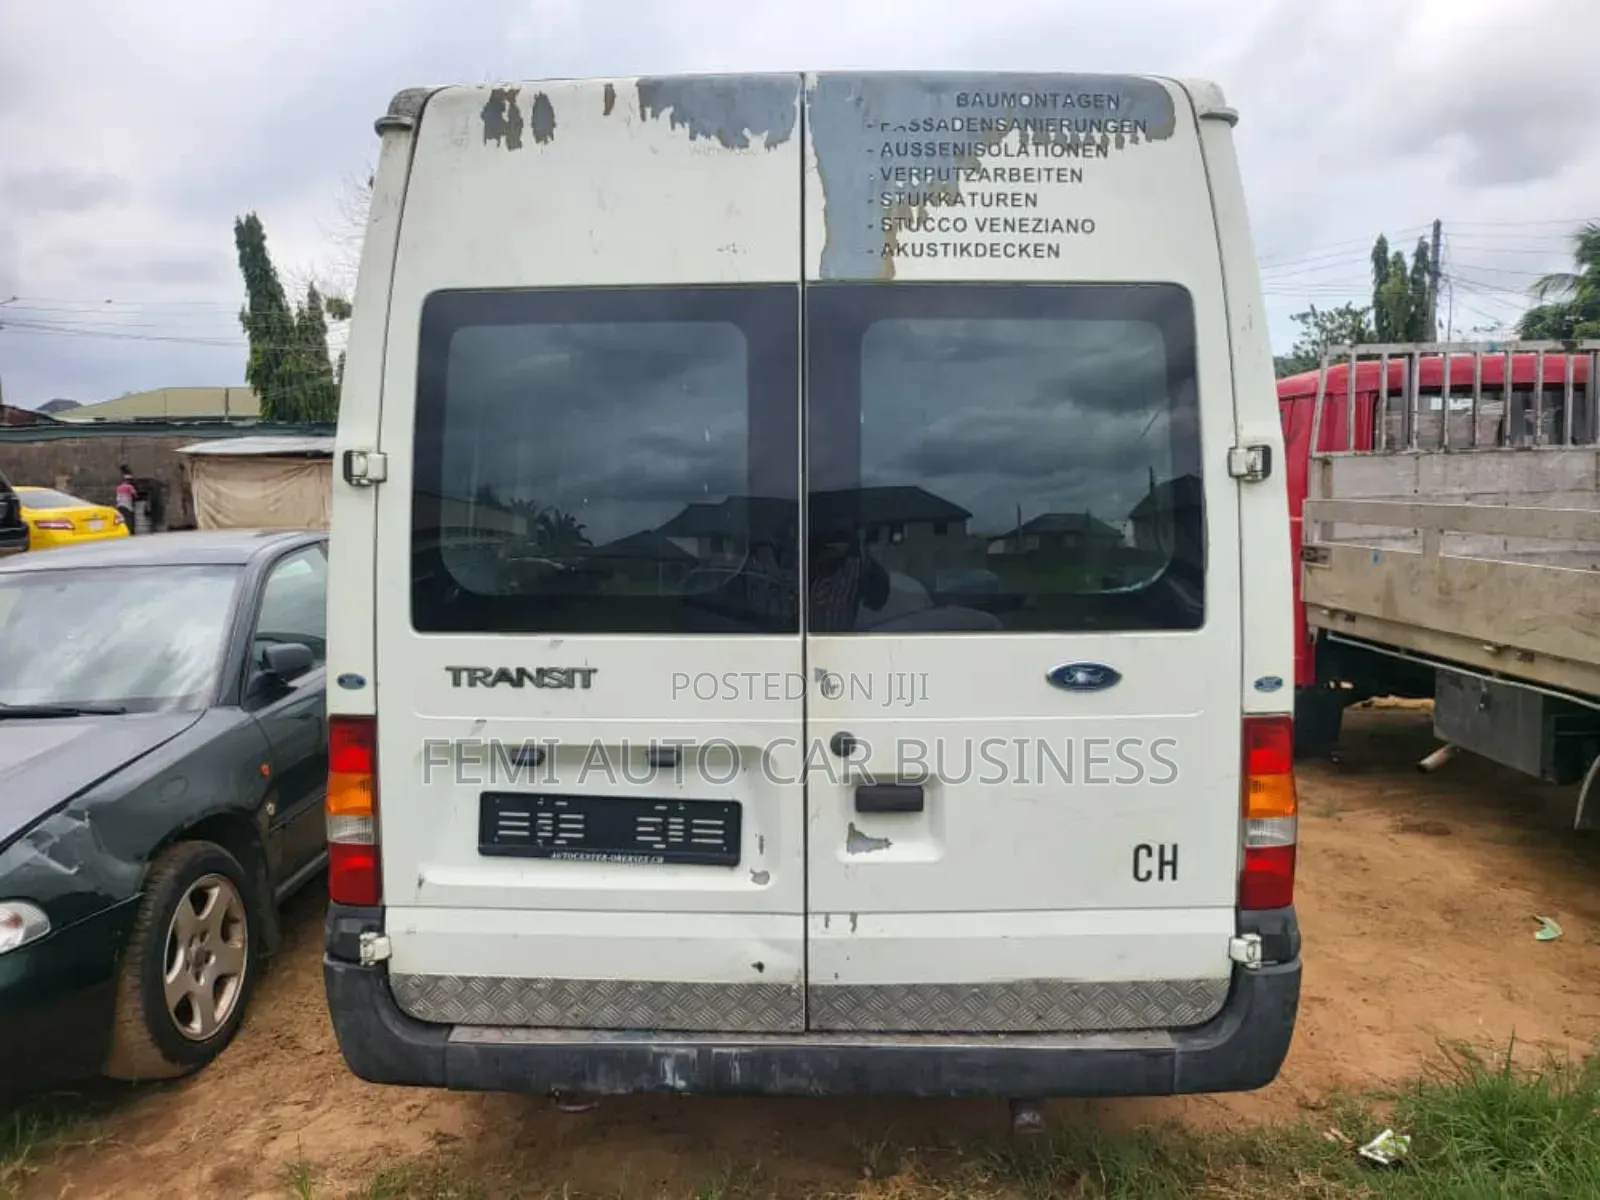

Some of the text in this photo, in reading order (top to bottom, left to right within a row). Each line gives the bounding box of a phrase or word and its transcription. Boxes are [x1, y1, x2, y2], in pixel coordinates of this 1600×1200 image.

[956, 92, 1120, 110] BAUMONTAGEN
[880, 142, 1109, 159] AUSSENISOLATIONEN
[880, 166, 1083, 183] VERPUTZARBEITEN
[880, 191, 1038, 208] STUKKATUREN
[880, 217, 967, 234] STUCCO
[975, 217, 1096, 235] VENEZIANO
[880, 241, 1061, 260] AKUSTIKDECKEN
[445, 665, 598, 689] TRANSIT
[1132, 843, 1179, 882] CH
